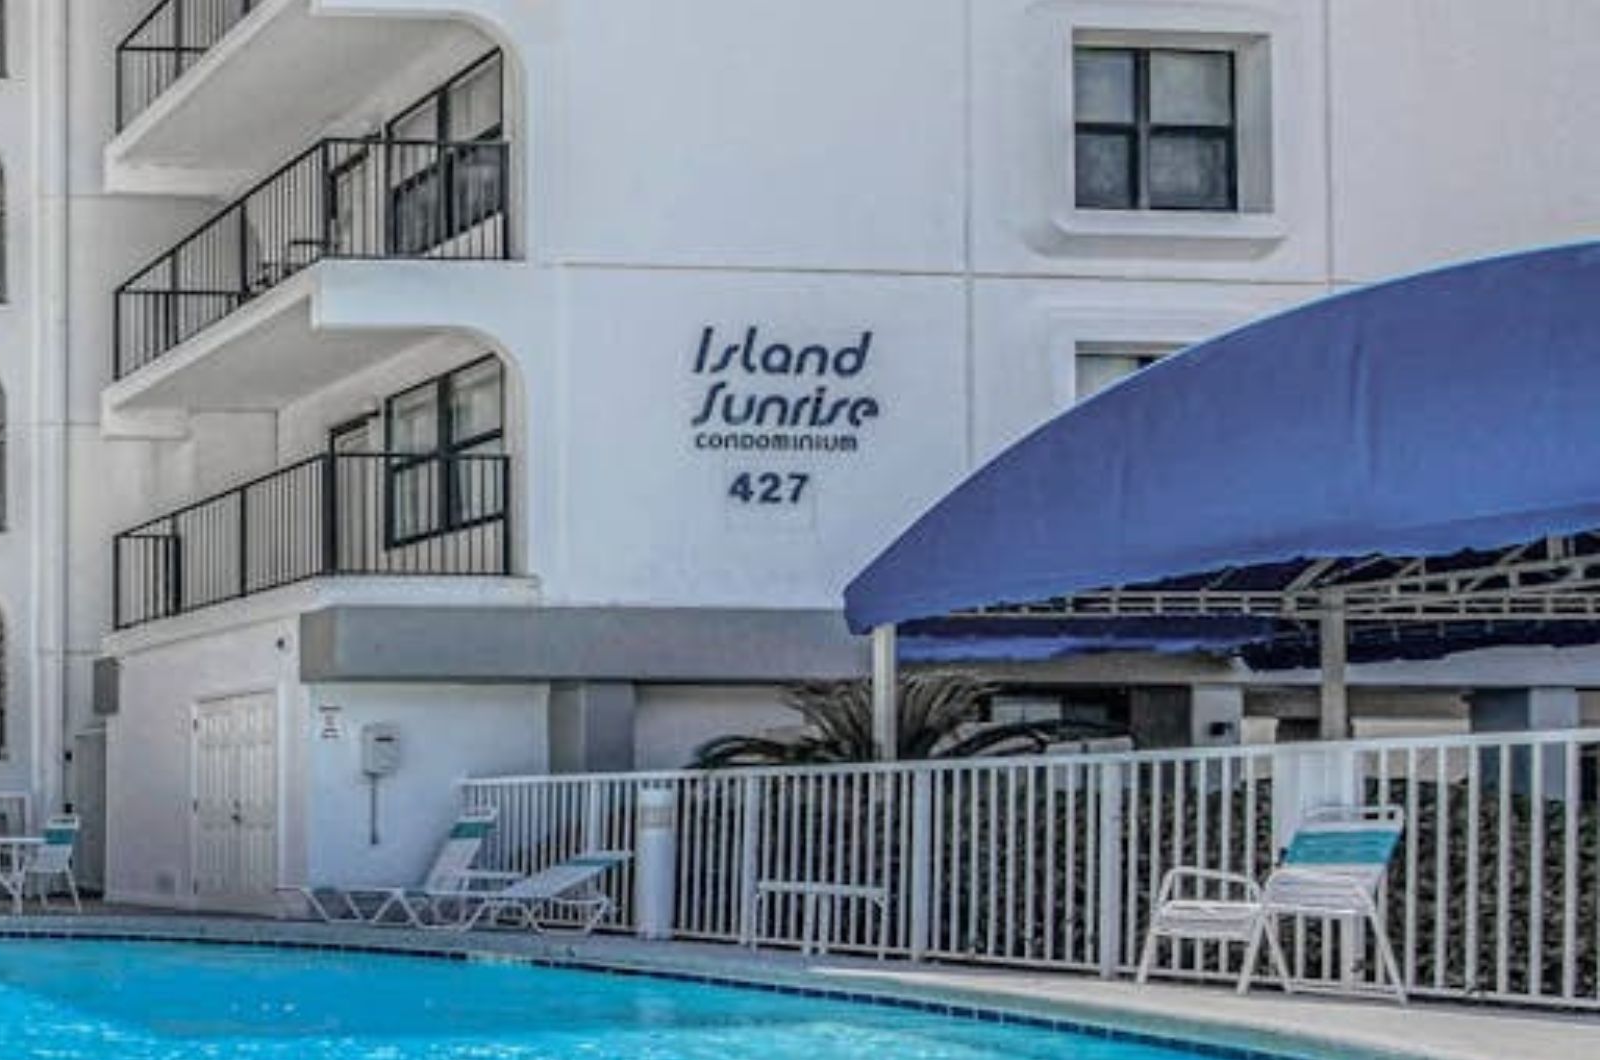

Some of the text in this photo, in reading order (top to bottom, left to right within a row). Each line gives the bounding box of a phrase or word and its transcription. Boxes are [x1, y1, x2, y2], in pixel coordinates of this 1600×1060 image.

[691, 326, 873, 377] Island
[691, 381, 879, 427] Sunrise
[728, 472, 810, 504] 427
